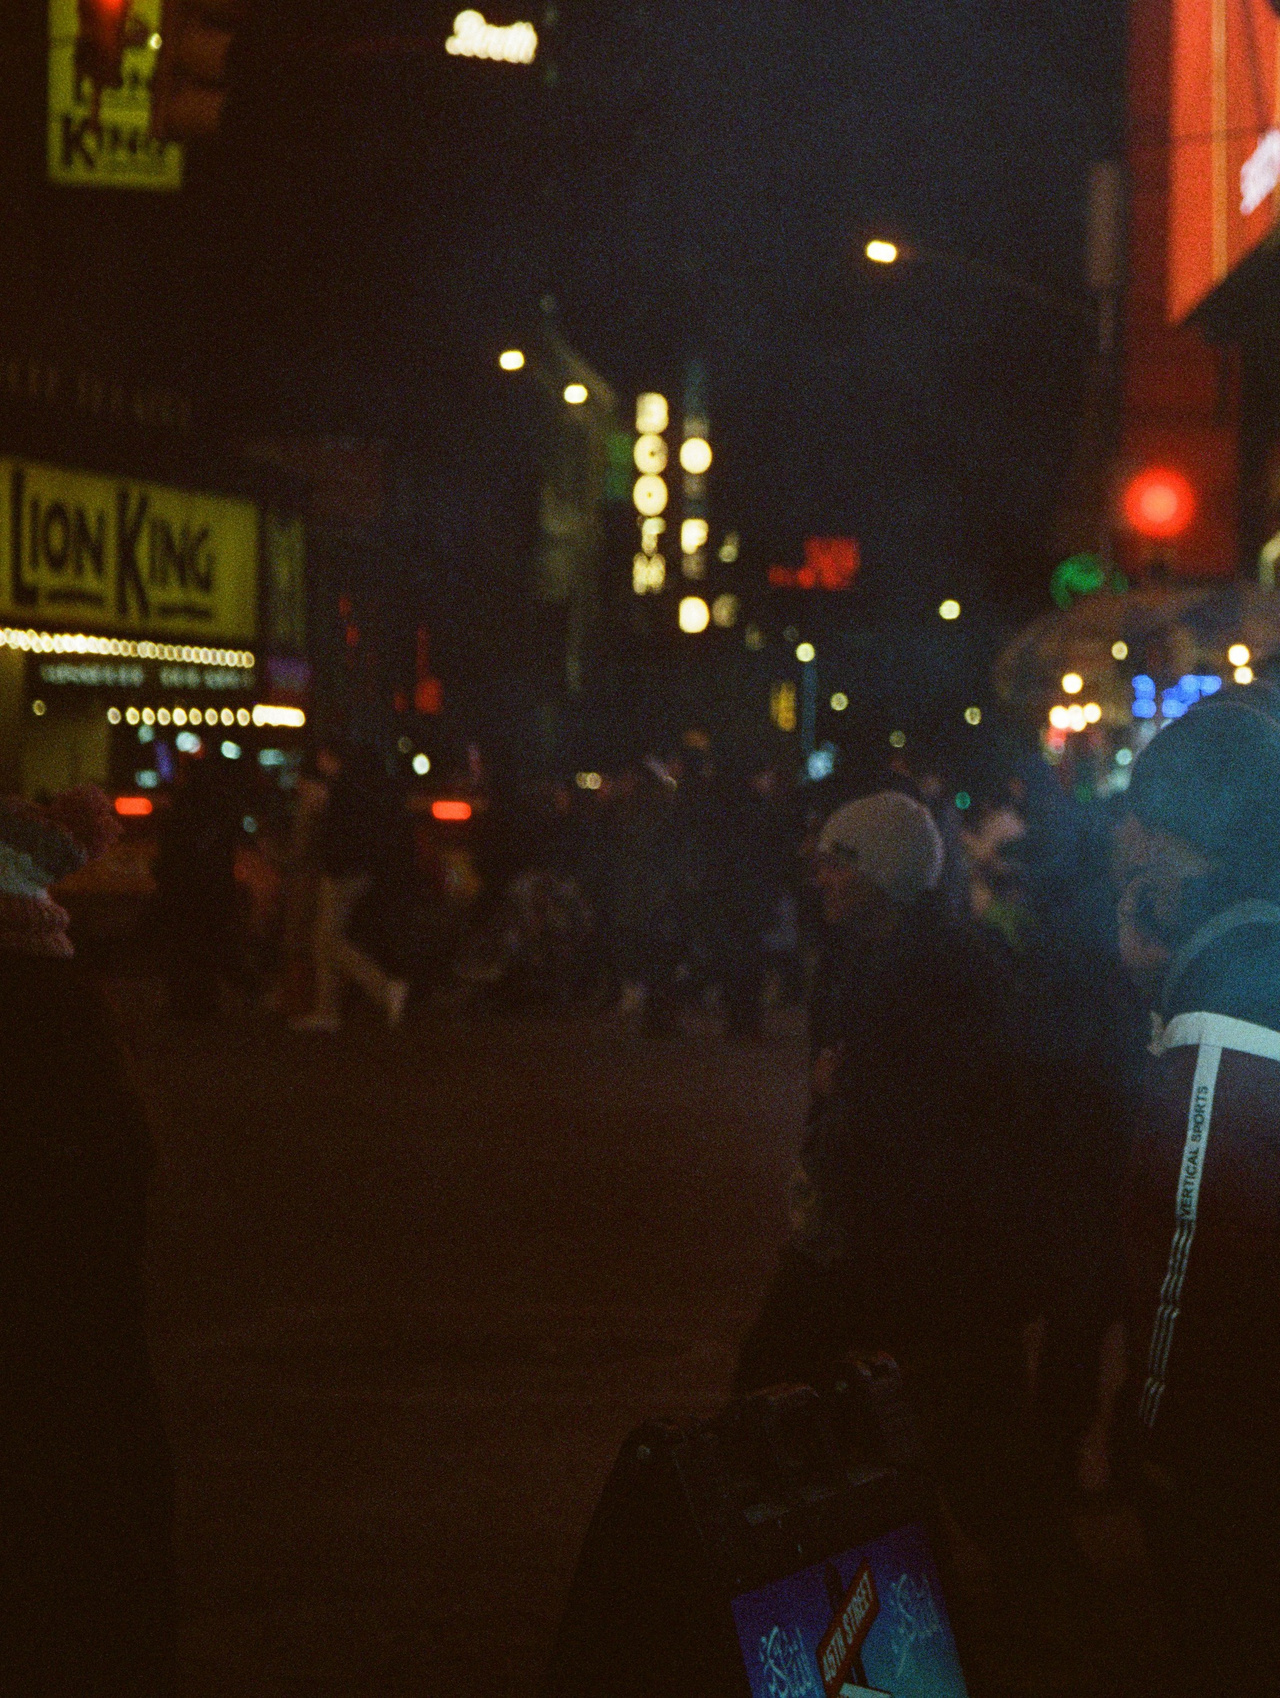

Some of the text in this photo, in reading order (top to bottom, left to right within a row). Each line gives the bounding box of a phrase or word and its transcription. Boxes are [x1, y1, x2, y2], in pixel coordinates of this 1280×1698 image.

[10, 467, 215, 620] LION KING
[1179, 1086, 1209, 1217] VERTICAL SPORTS
[843, 1570, 872, 1645] STREET
